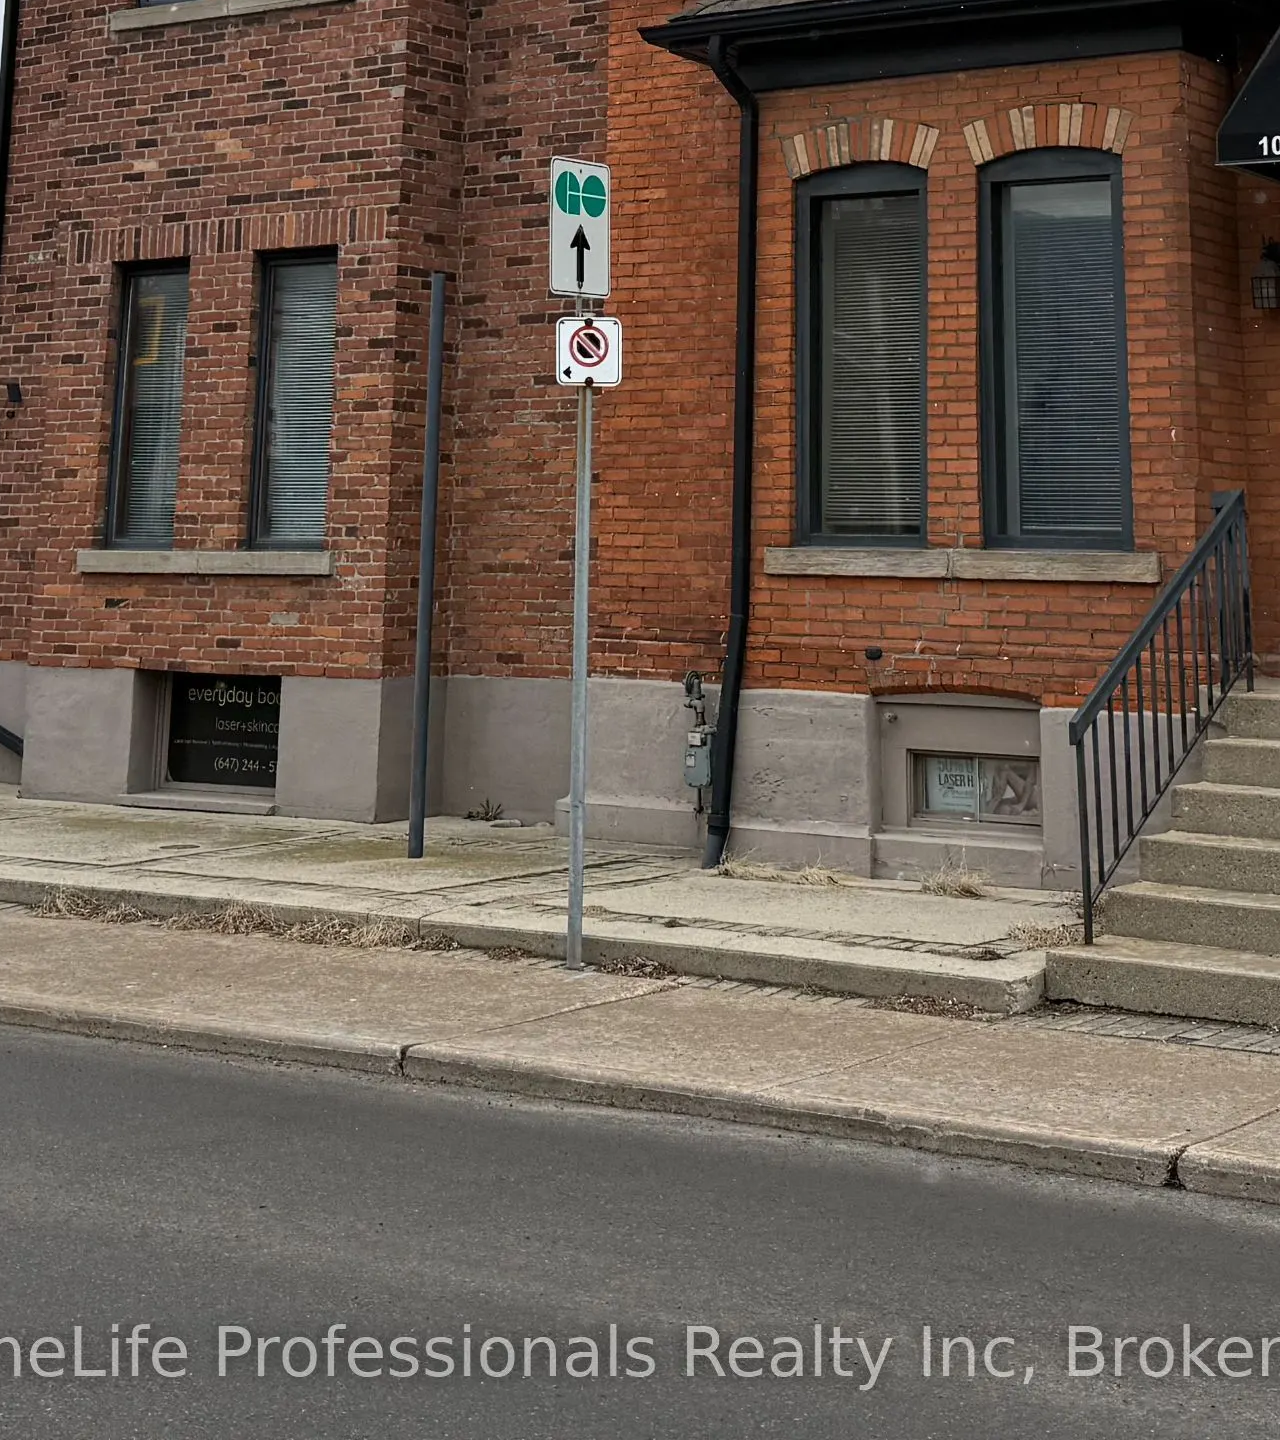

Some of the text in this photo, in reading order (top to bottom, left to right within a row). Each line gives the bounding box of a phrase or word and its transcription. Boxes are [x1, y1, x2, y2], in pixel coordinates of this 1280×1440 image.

[555, 170, 607, 218] GO
[188, 686, 253, 707] everyday
[214, 757, 240, 772] (647)
[242, 758, 260, 772] 244
[938, 773, 966, 787] LASER
